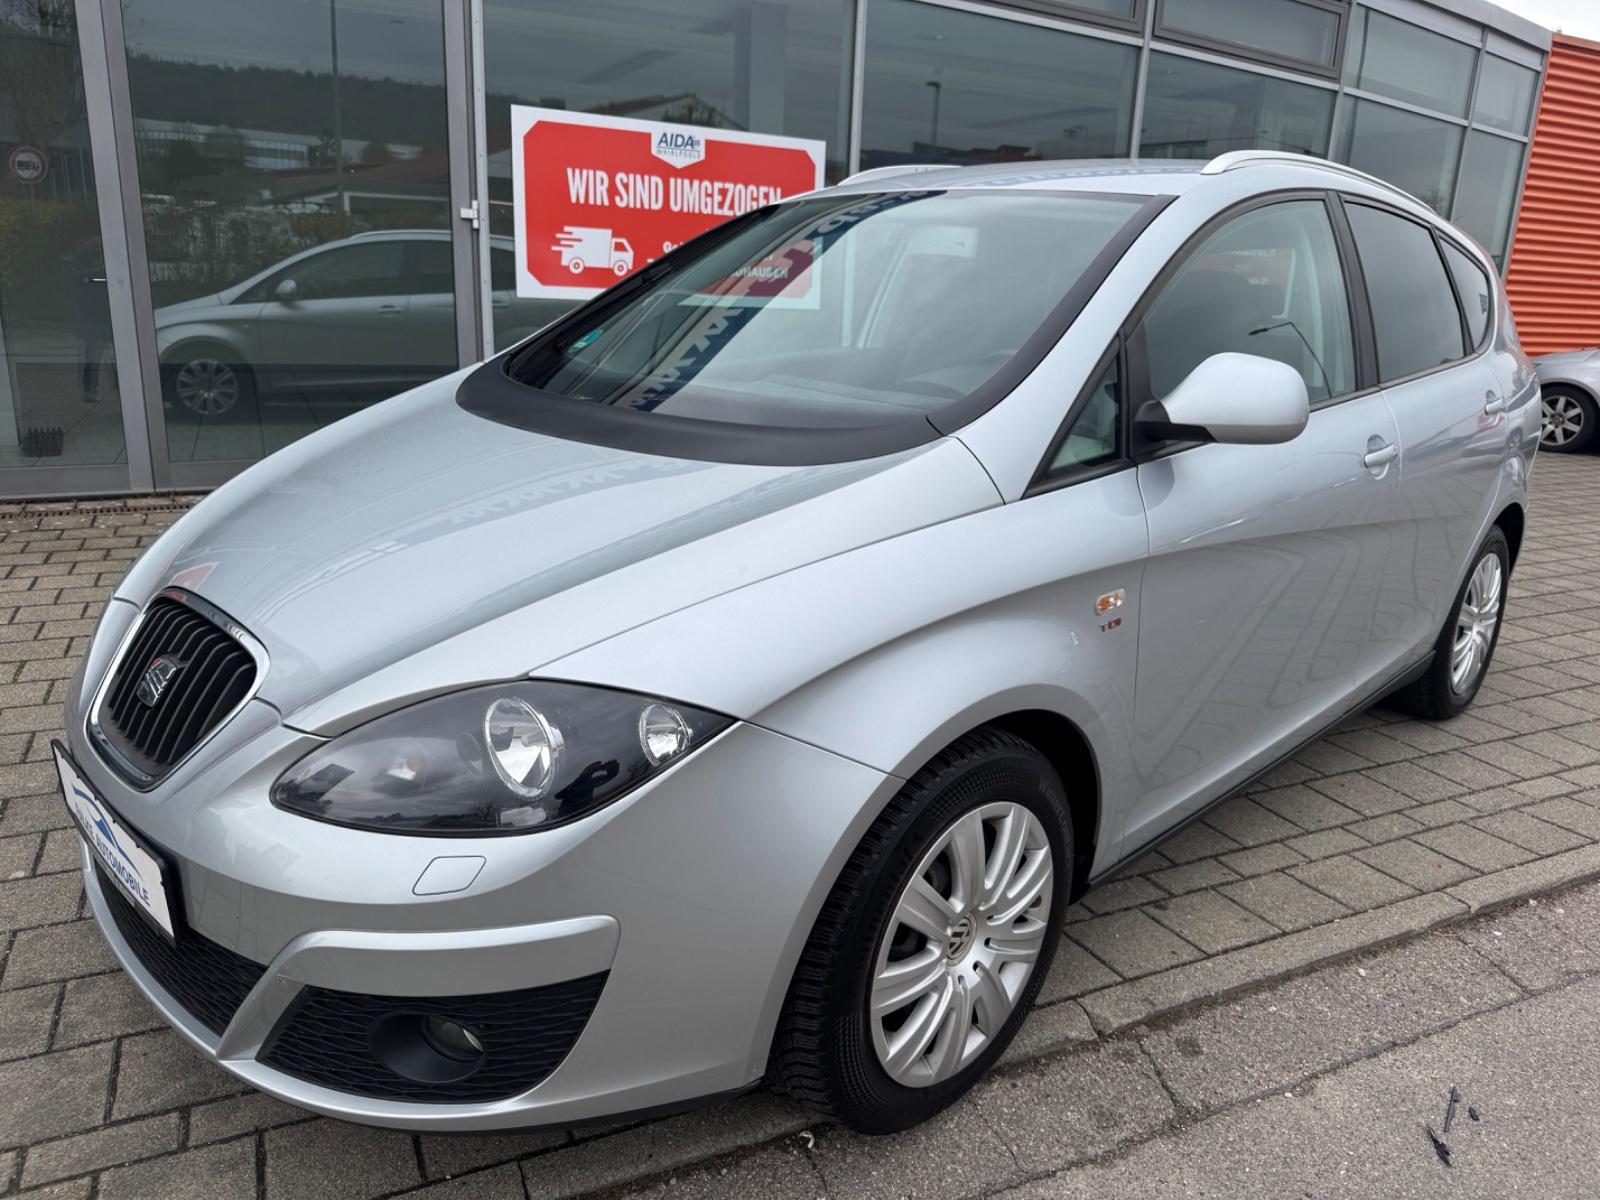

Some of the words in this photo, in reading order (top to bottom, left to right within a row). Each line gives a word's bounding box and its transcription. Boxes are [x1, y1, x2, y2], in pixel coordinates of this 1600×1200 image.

[658, 132, 695, 149] AIDA
[567, 168, 608, 207] WIR
[615, 172, 664, 210] SIND
[96, 833, 151, 907] AUTOMOBILE
